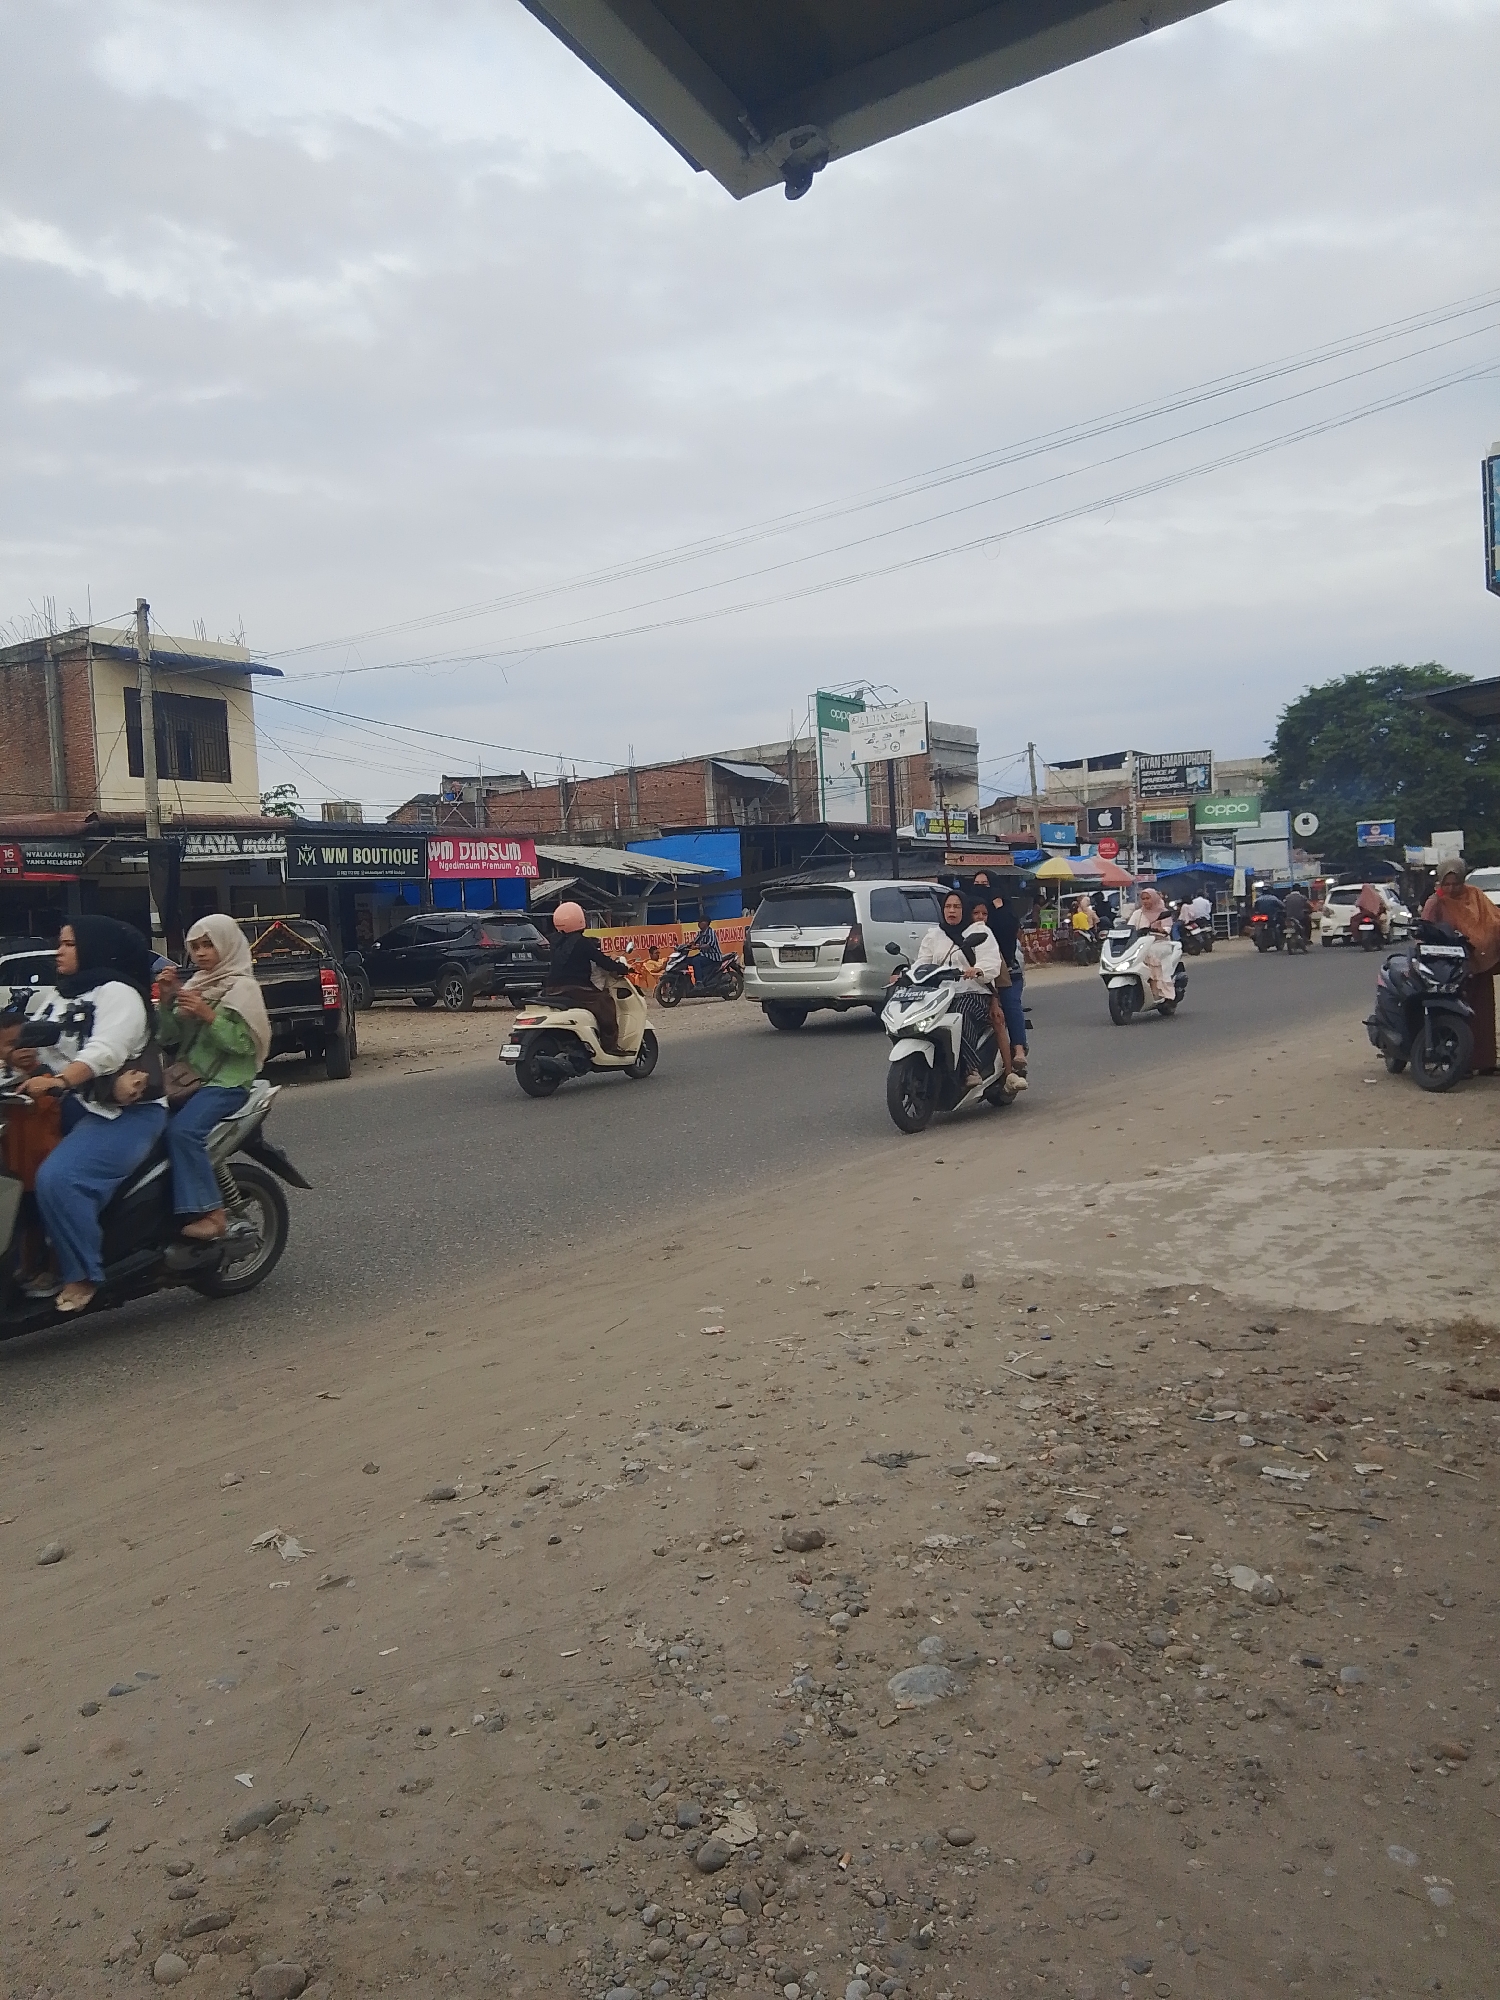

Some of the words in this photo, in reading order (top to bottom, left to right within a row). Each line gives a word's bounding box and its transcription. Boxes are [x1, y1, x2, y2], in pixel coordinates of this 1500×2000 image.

[1140, 756, 1161, 770] RYAN
[1161, 751, 1211, 768] SMARTPHONE
[1204, 803, 1250, 817] oppo
[321, 847, 348, 864] WM
[352, 847, 419, 866] BOUTIQUE
[428, 840, 453, 861] WM
[459, 841, 521, 861] DIMSUM
[439, 861, 480, 871] Ngedimsum
[482, 862, 512, 870] Premium
[515, 865, 537, 876] 2.000
[640, 933, 668, 949] DURIAN
